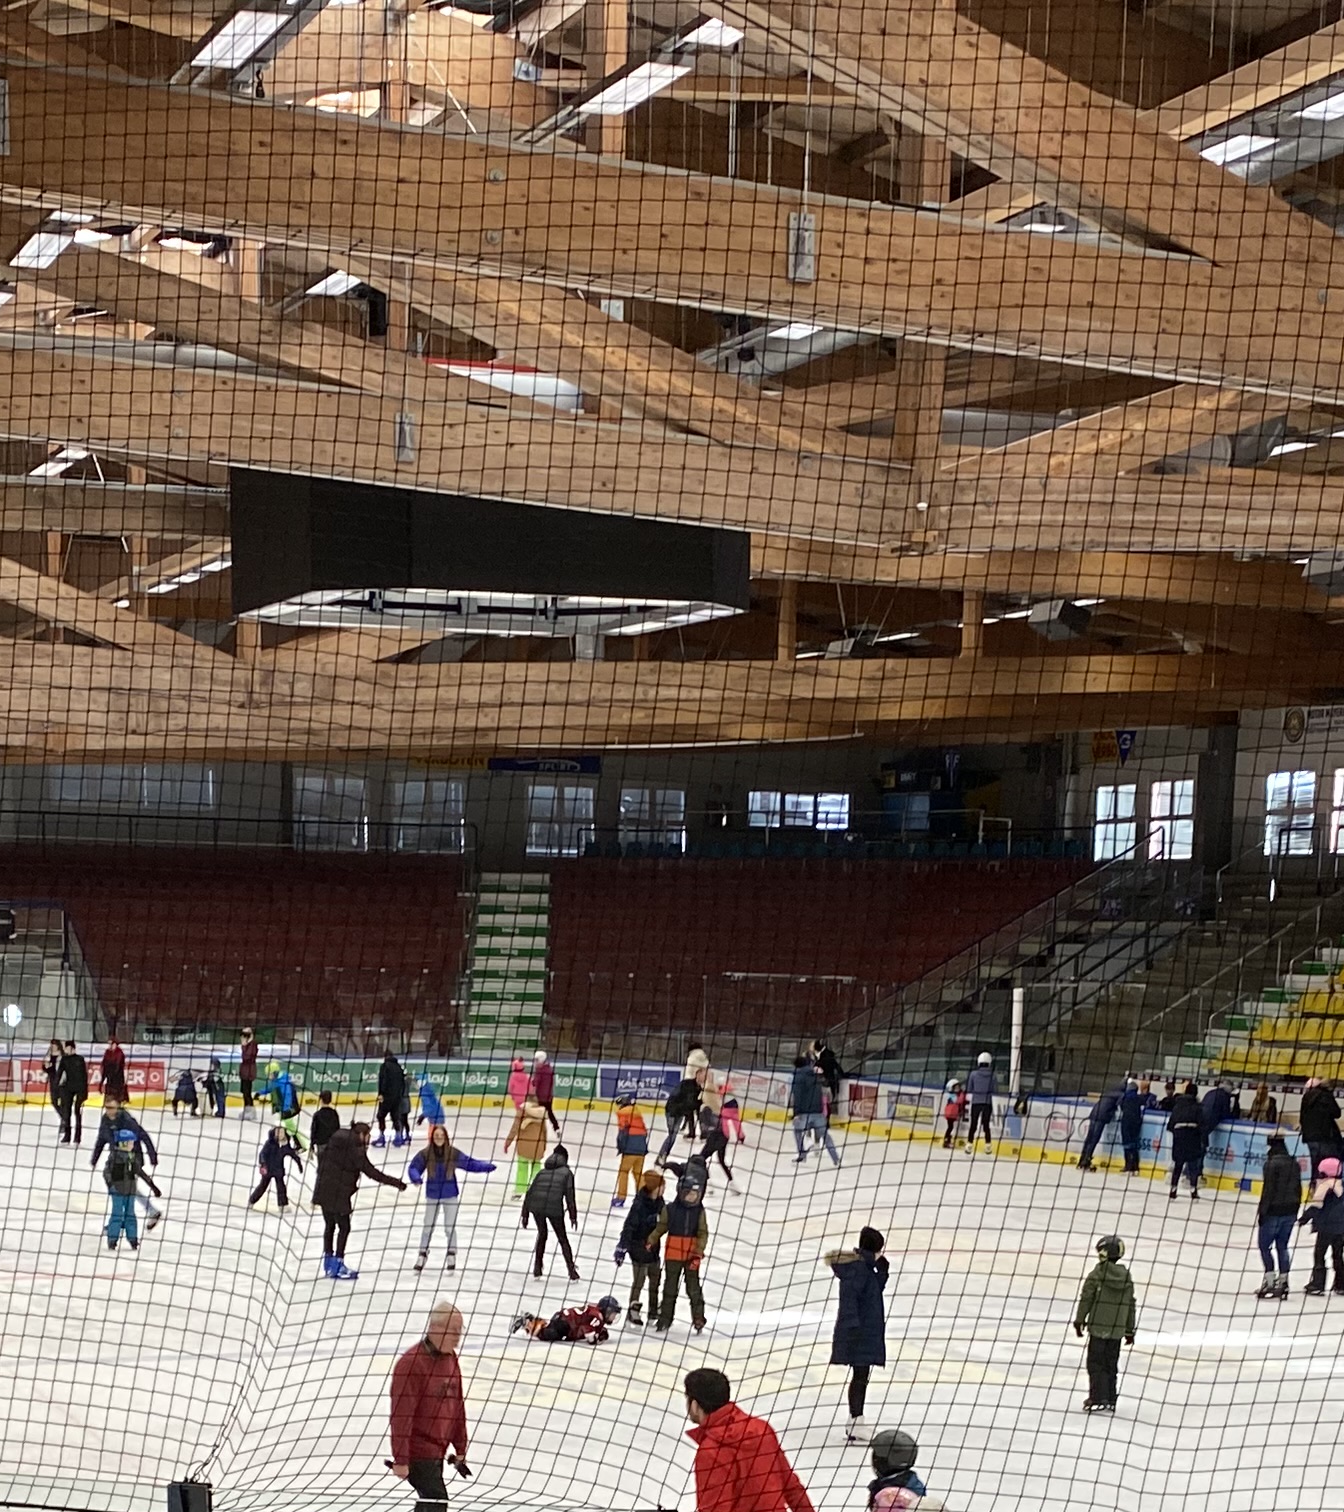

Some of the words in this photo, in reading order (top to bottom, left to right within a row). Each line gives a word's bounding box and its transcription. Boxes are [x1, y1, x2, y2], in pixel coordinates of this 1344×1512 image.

[1119, 733, 1131, 749] G
[312, 1068, 350, 1086] kelag
[462, 1071, 499, 1088] kelag
[556, 1072, 592, 1091] kelag
